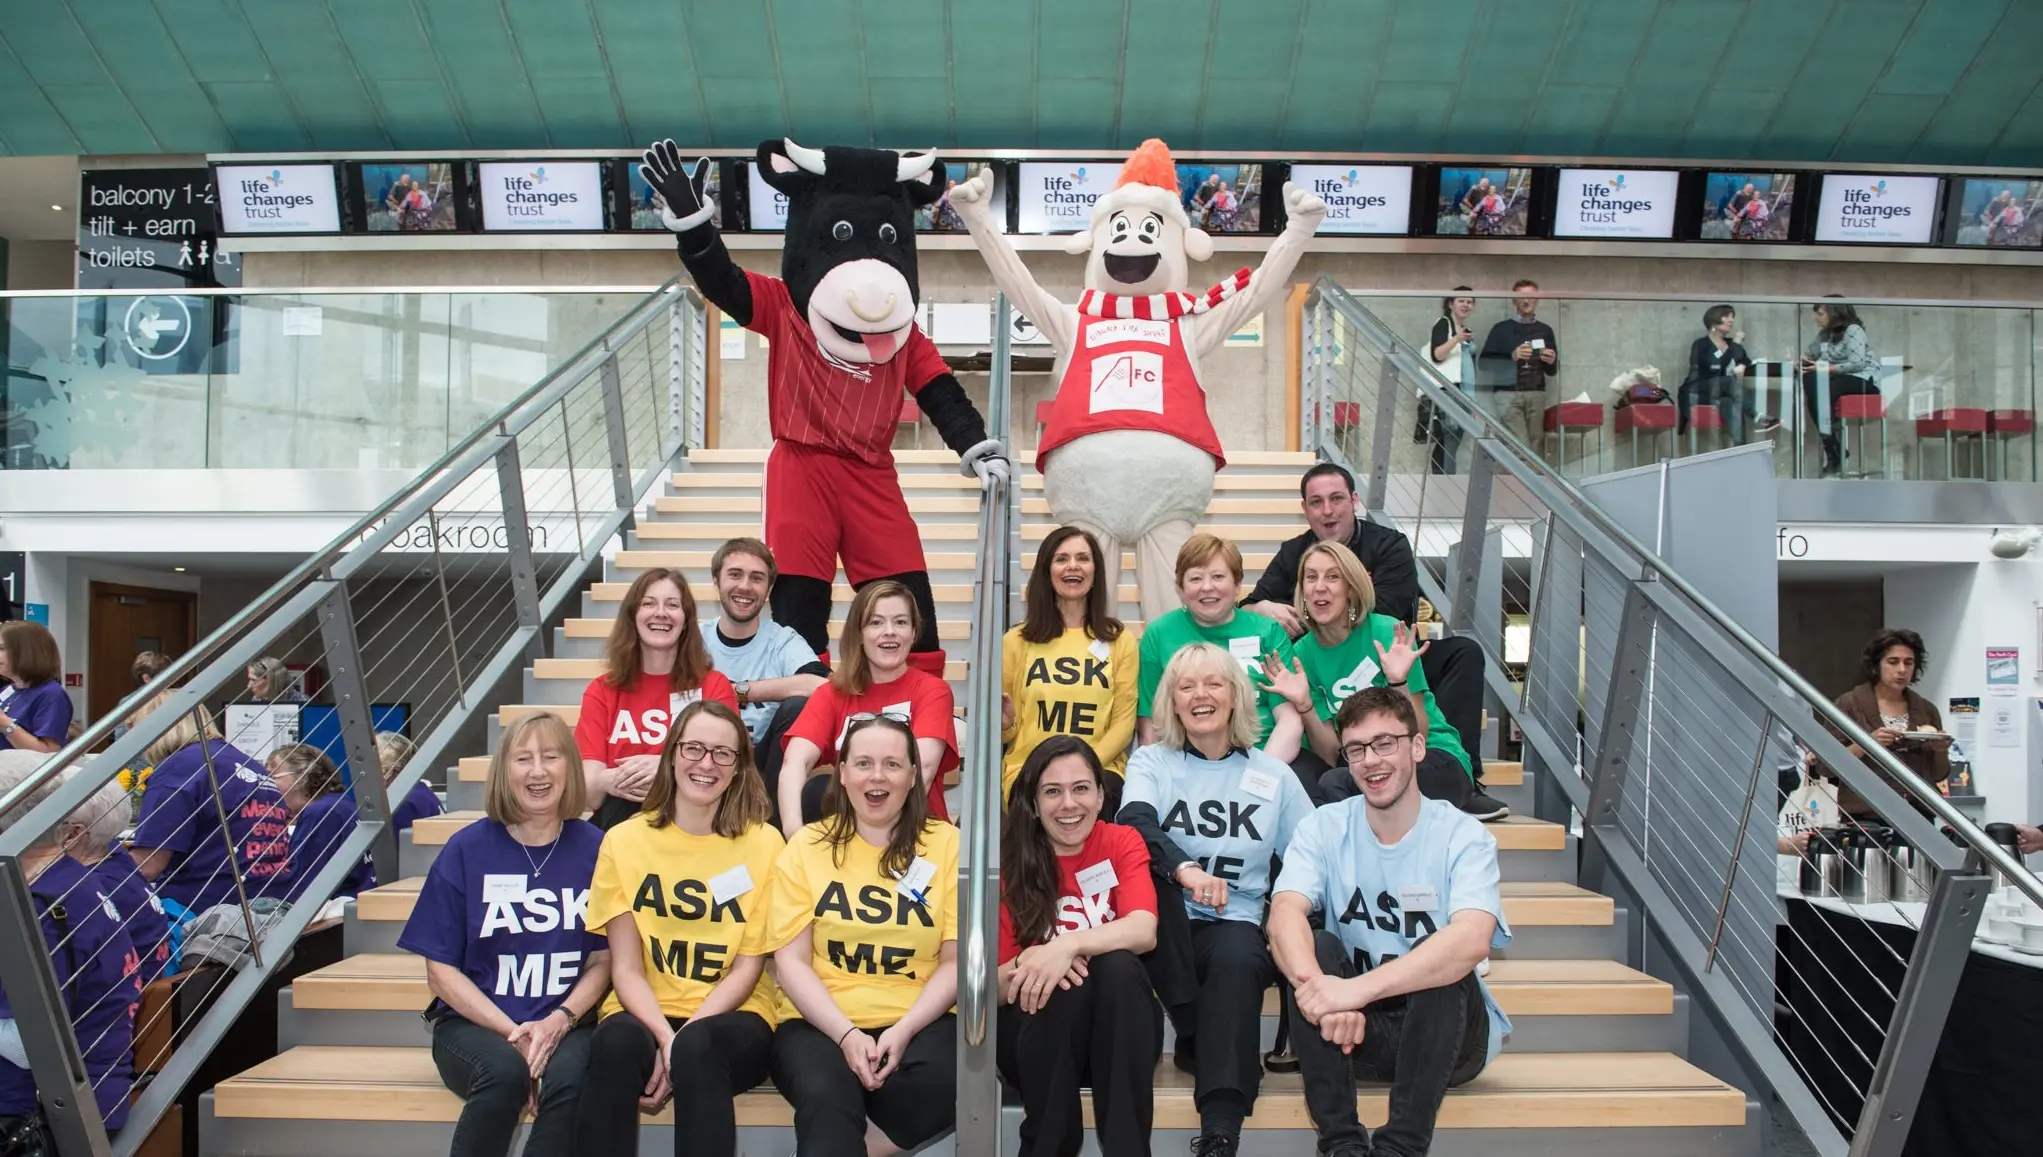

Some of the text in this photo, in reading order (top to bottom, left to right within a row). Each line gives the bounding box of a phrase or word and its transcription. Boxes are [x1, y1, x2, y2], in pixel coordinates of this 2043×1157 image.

[241, 180, 269, 193] life
[504, 177, 532, 190] life
[1044, 177, 1072, 190] life
[1315, 179, 1343, 193] life
[1582, 184, 1610, 197] life
[91, 184, 175, 210] balcony
[243, 193, 314, 208] changes
[506, 190, 578, 206] changes
[1044, 190, 1102, 207] chang
[1319, 193, 1386, 209] hanges
[1844, 189, 1871, 202] life
[244, 207, 282, 218] trust
[507, 204, 545, 216] trust
[1044, 205, 1082, 216] trust
[1325, 206, 1351, 218] ust
[1581, 197, 1652, 213] changes
[1842, 203, 1912, 219] changes
[1580, 210, 1617, 223] trust
[1840, 215, 1877, 228] trust
[90, 216, 115, 237] tilt
[145, 218, 196, 236] earn
[90, 246, 156, 268] toilets
[1025, 656, 1110, 690] ASK
[1037, 700, 1098, 736] ME
[609, 708, 674, 746] AS
[1160, 798, 1264, 842] ASK
[814, 880, 935, 928] ASK
[479, 887, 591, 938] ASK
[1046, 888, 1116, 938] SK
[649, 935, 729, 984] ME
[827, 939, 917, 980] ME
[494, 950, 582, 998] ME
